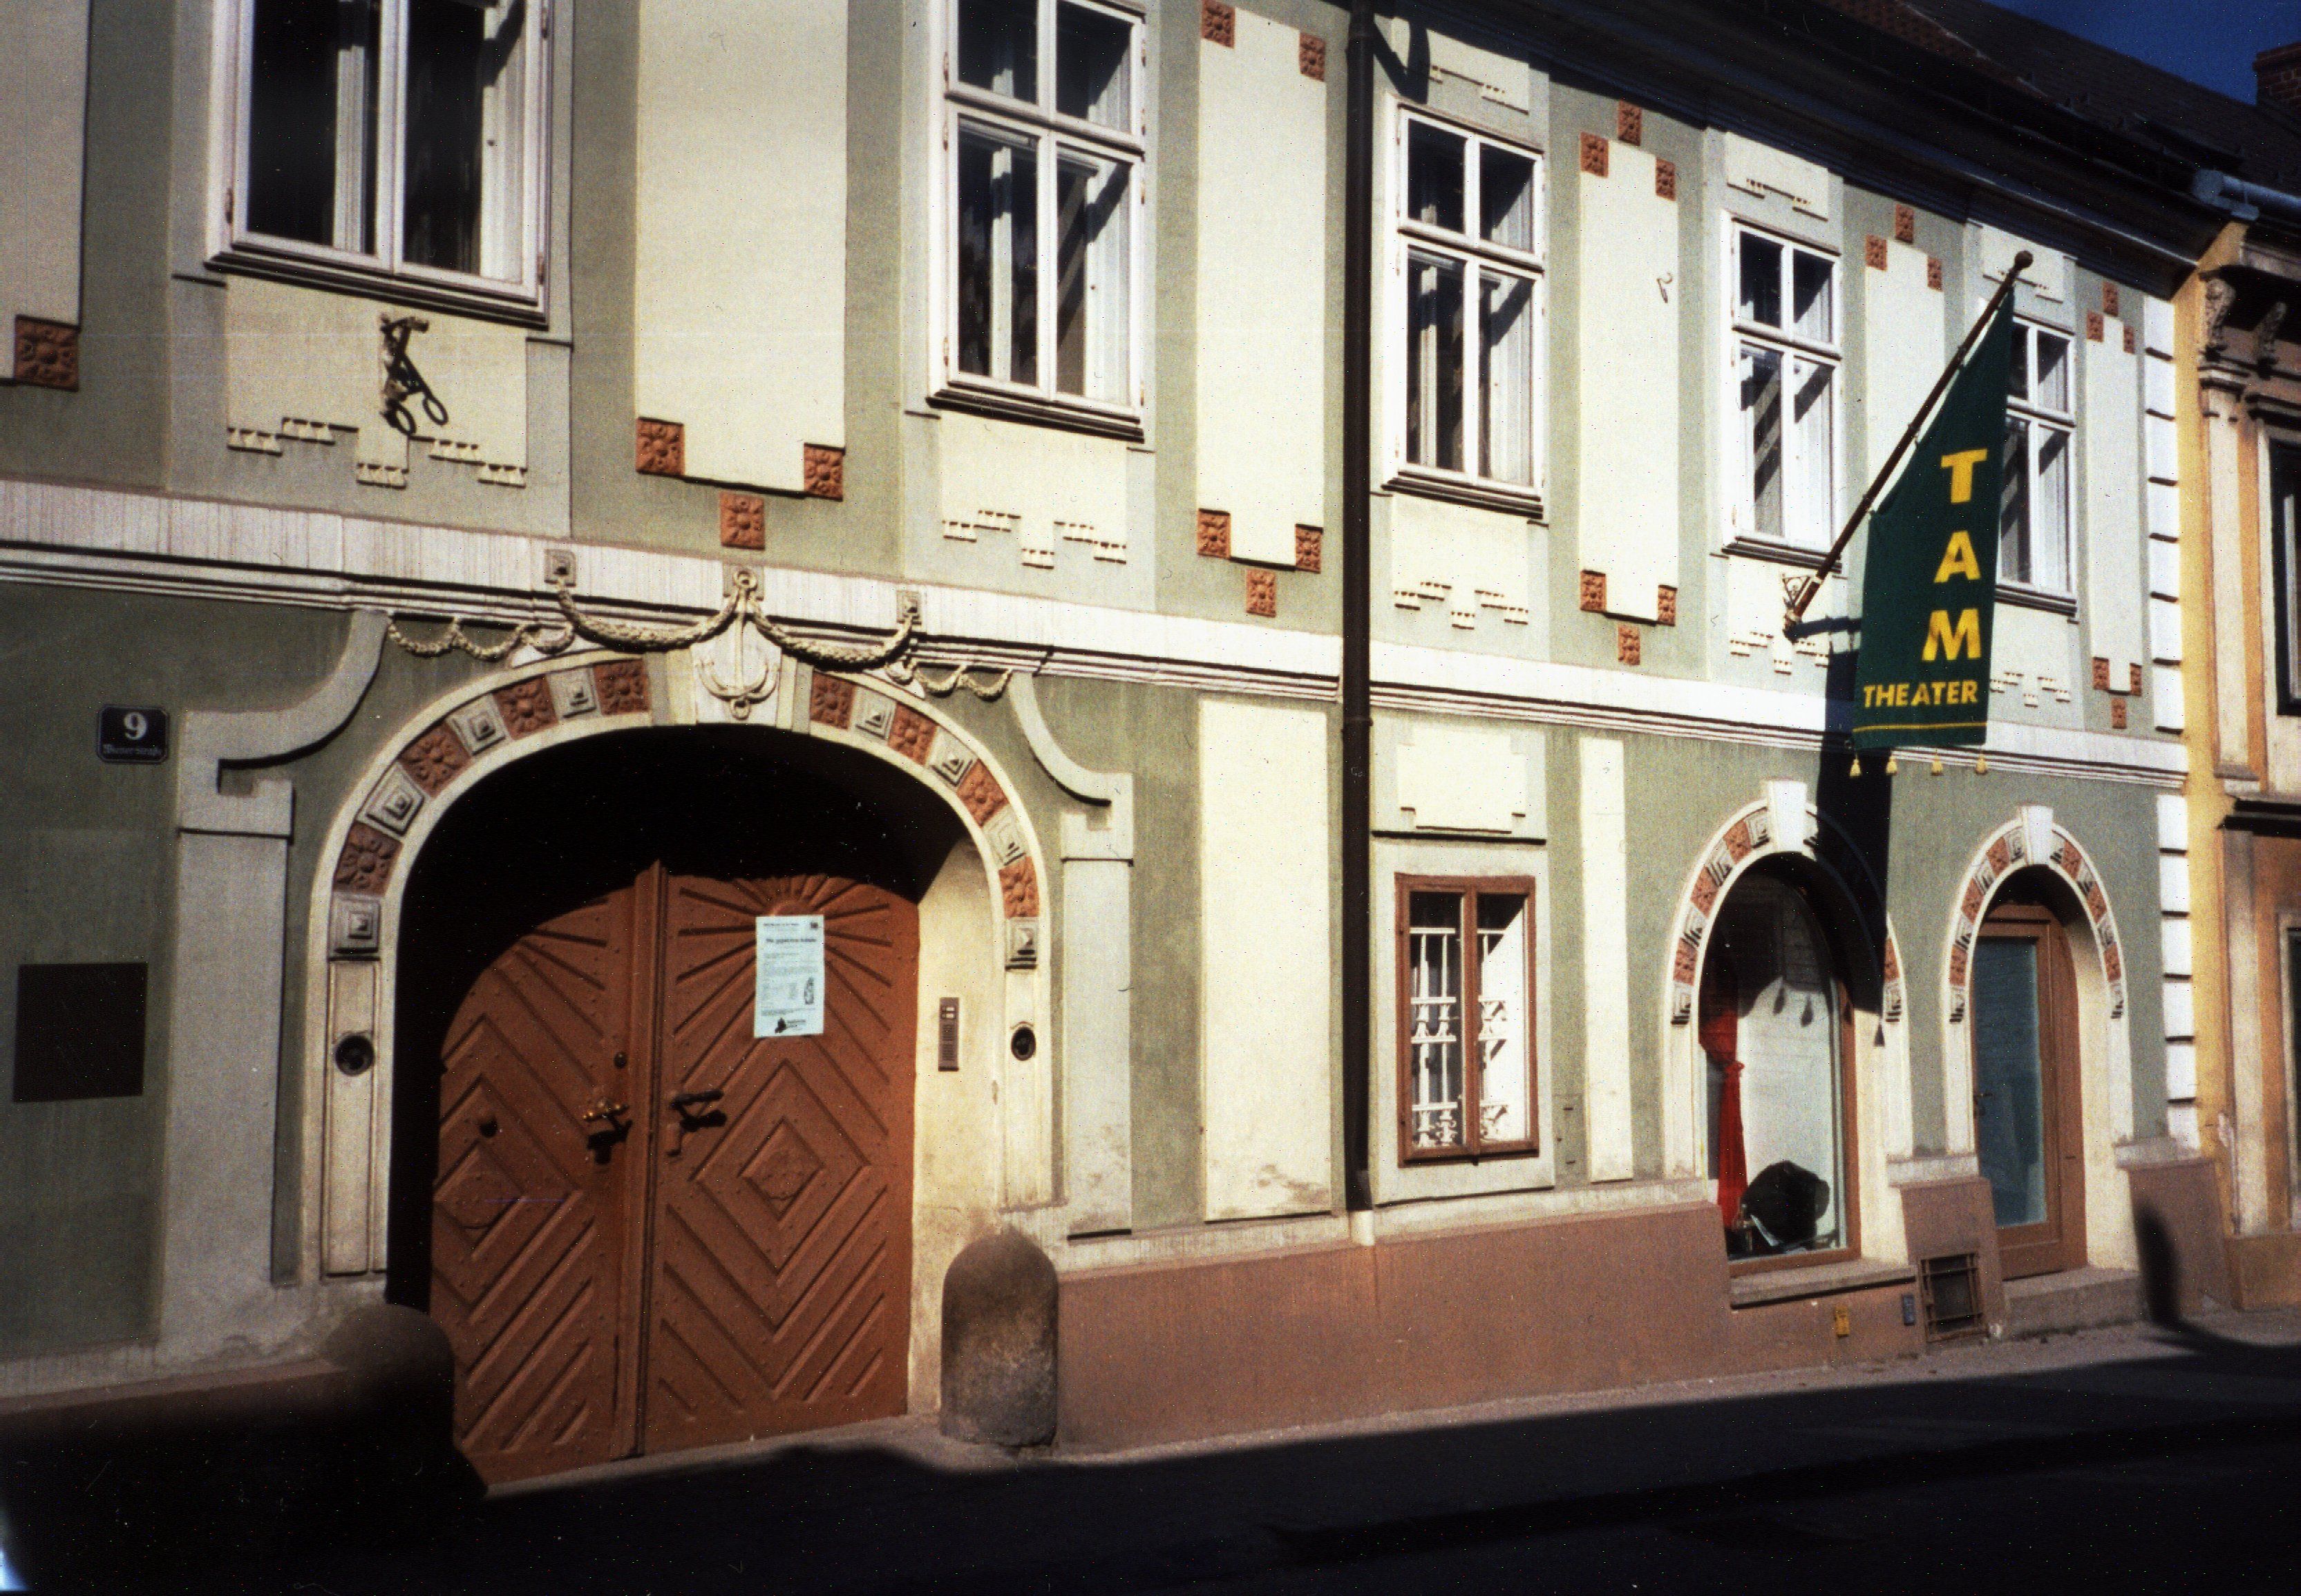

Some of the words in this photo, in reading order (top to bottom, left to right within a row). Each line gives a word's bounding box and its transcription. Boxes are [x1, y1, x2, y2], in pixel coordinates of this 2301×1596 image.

[1922, 449, 1987, 661] TAM
[1864, 681, 1978, 707] THEATER
[124, 712, 146, 740] 9
